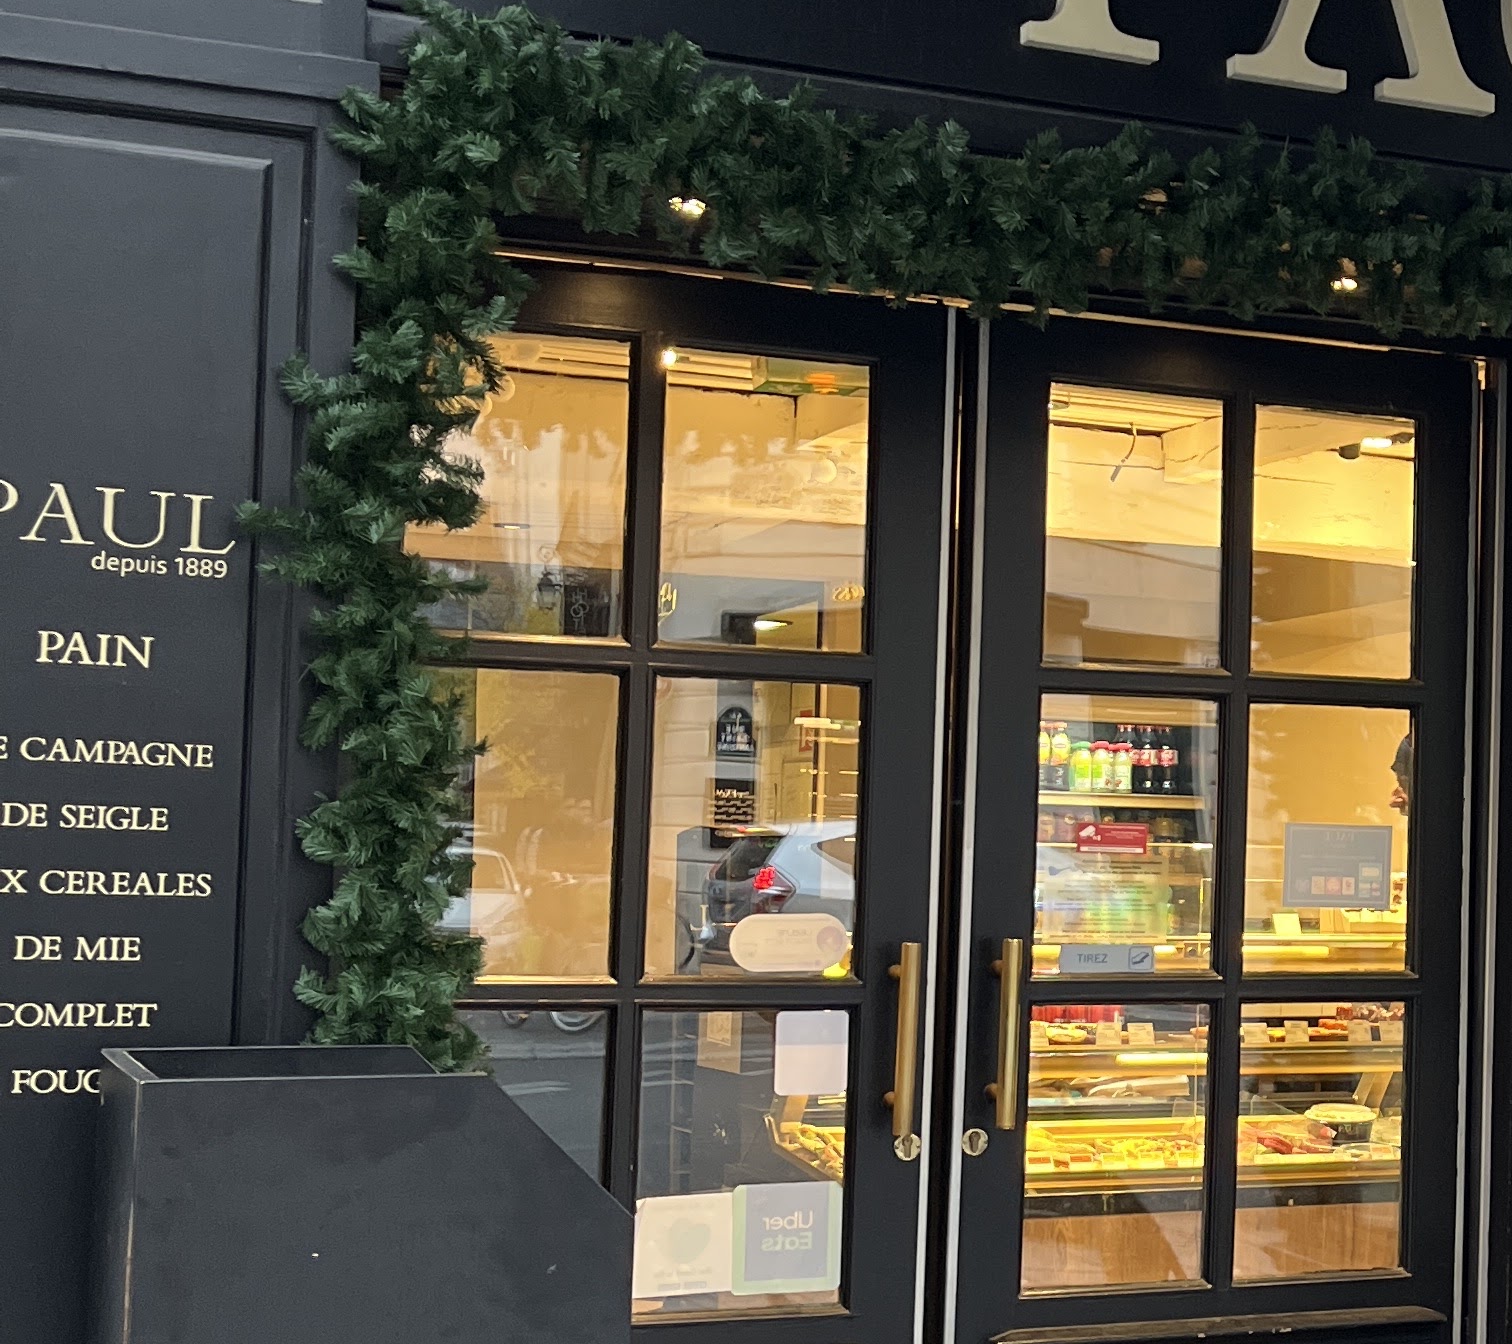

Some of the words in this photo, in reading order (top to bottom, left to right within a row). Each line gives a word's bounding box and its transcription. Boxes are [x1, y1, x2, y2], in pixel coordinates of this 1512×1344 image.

[91, 550, 168, 577] depuis
[174, 556, 228, 579] 1889
[36, 630, 155, 669] PAIN
[20, 736, 214, 768] CAMPAGNE
[1, 802, 48, 827] DE
[59, 804, 169, 831] SEIGLE
[39, 869, 212, 897] CEREALES
[14, 935, 62, 961] DE
[73, 936, 141, 961] MIE
[1076, 953, 1109, 964] TIREZ
